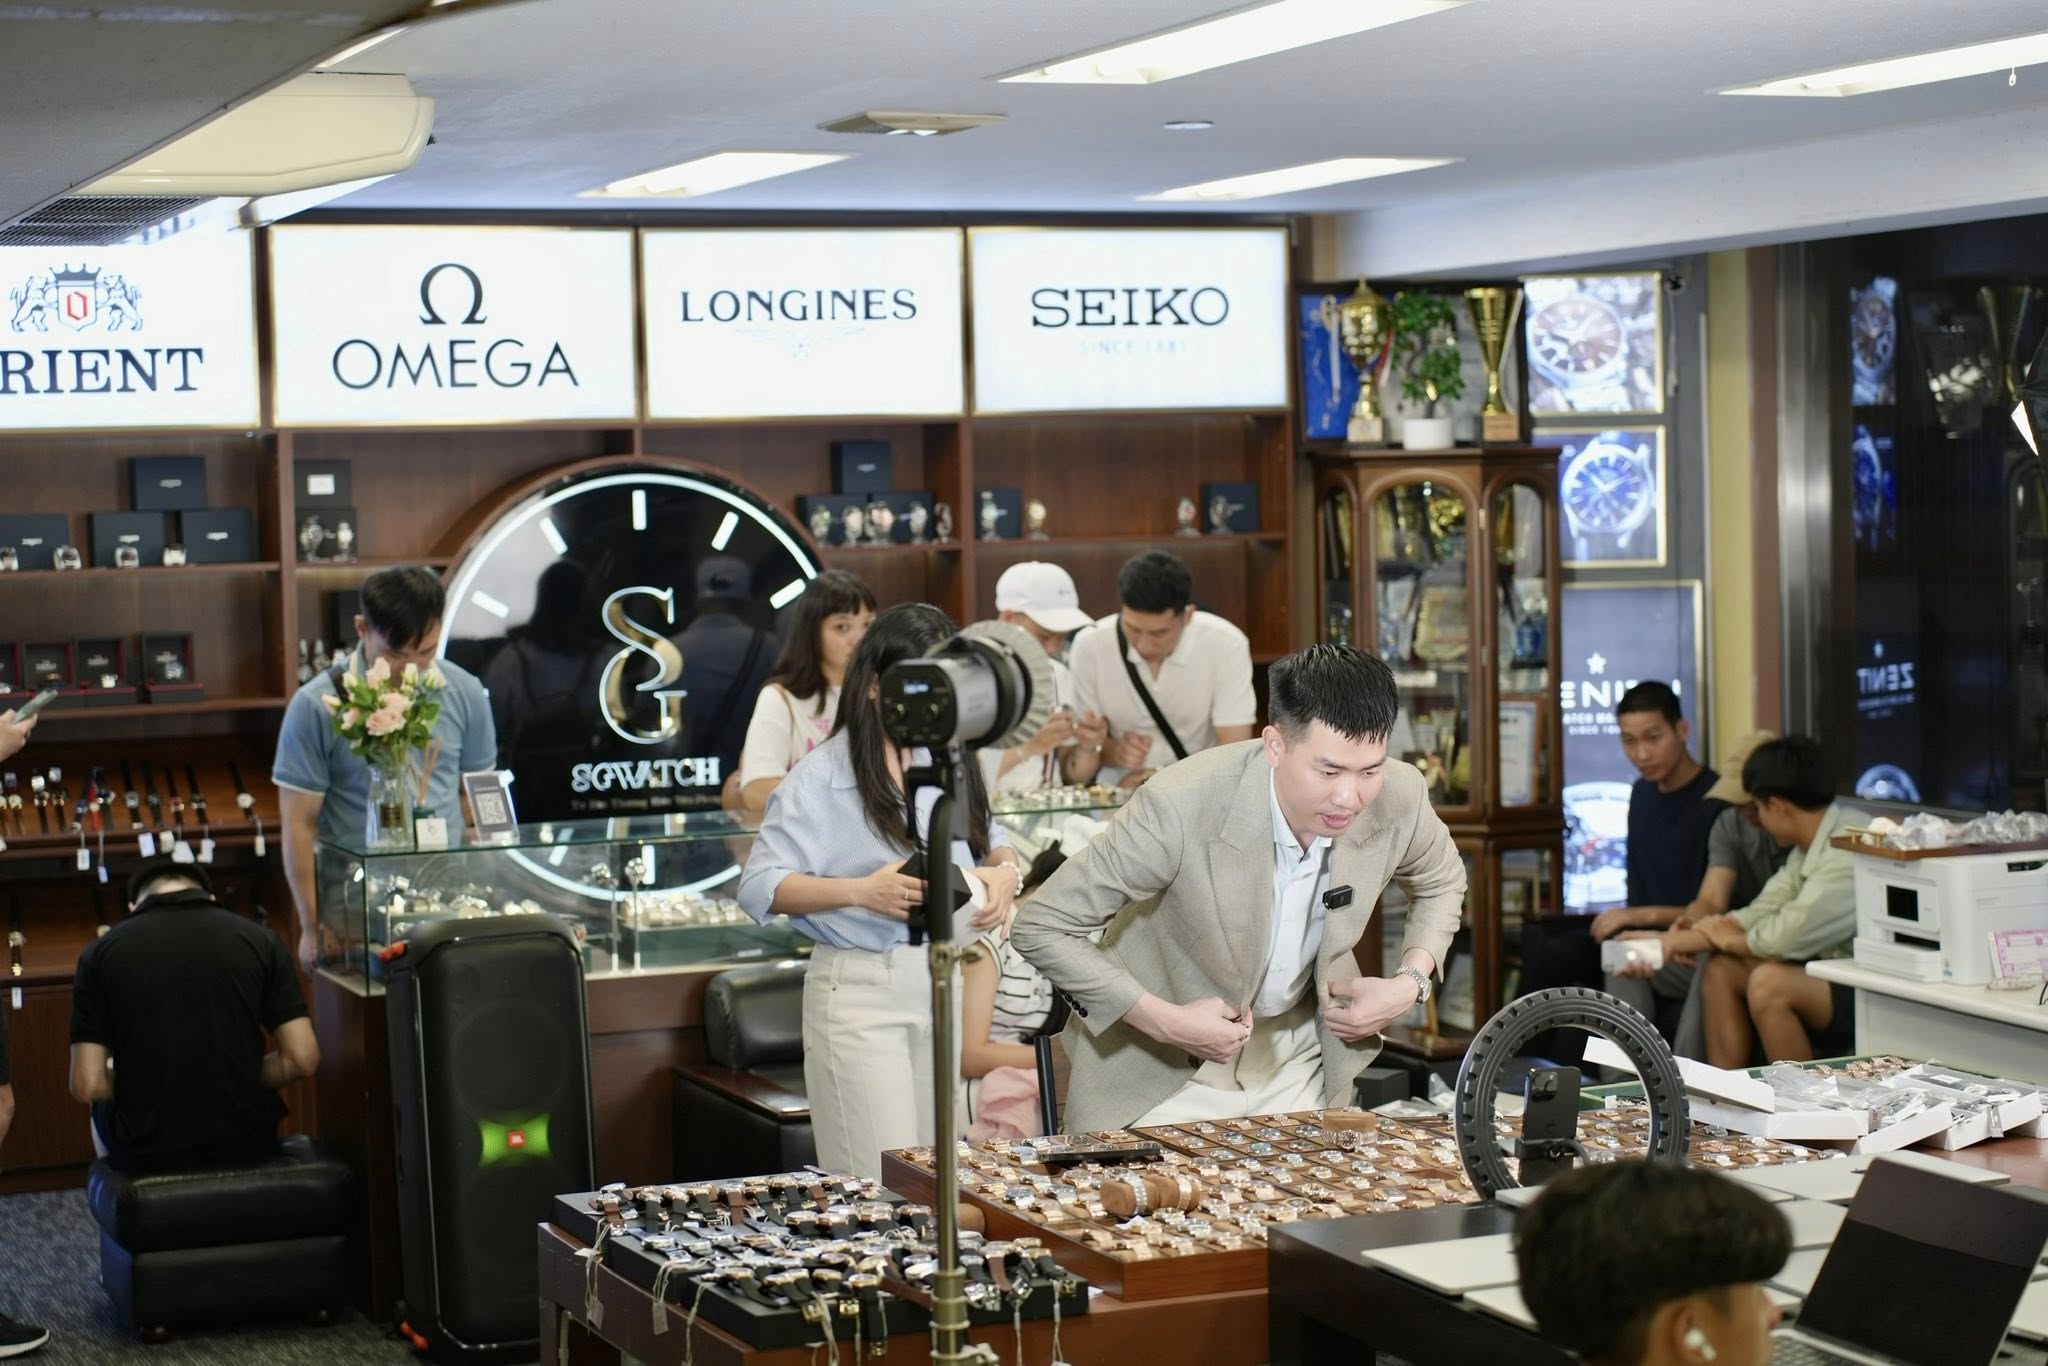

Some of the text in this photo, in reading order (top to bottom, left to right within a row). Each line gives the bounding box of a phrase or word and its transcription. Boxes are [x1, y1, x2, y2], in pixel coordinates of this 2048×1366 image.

[681, 288, 917, 323] LONGINES
[1031, 286, 1230, 329] SEIKO
[0, 347, 204, 395] RIENT
[332, 338, 579, 390] OMEGA
[571, 756, 721, 793] SGWATCH
